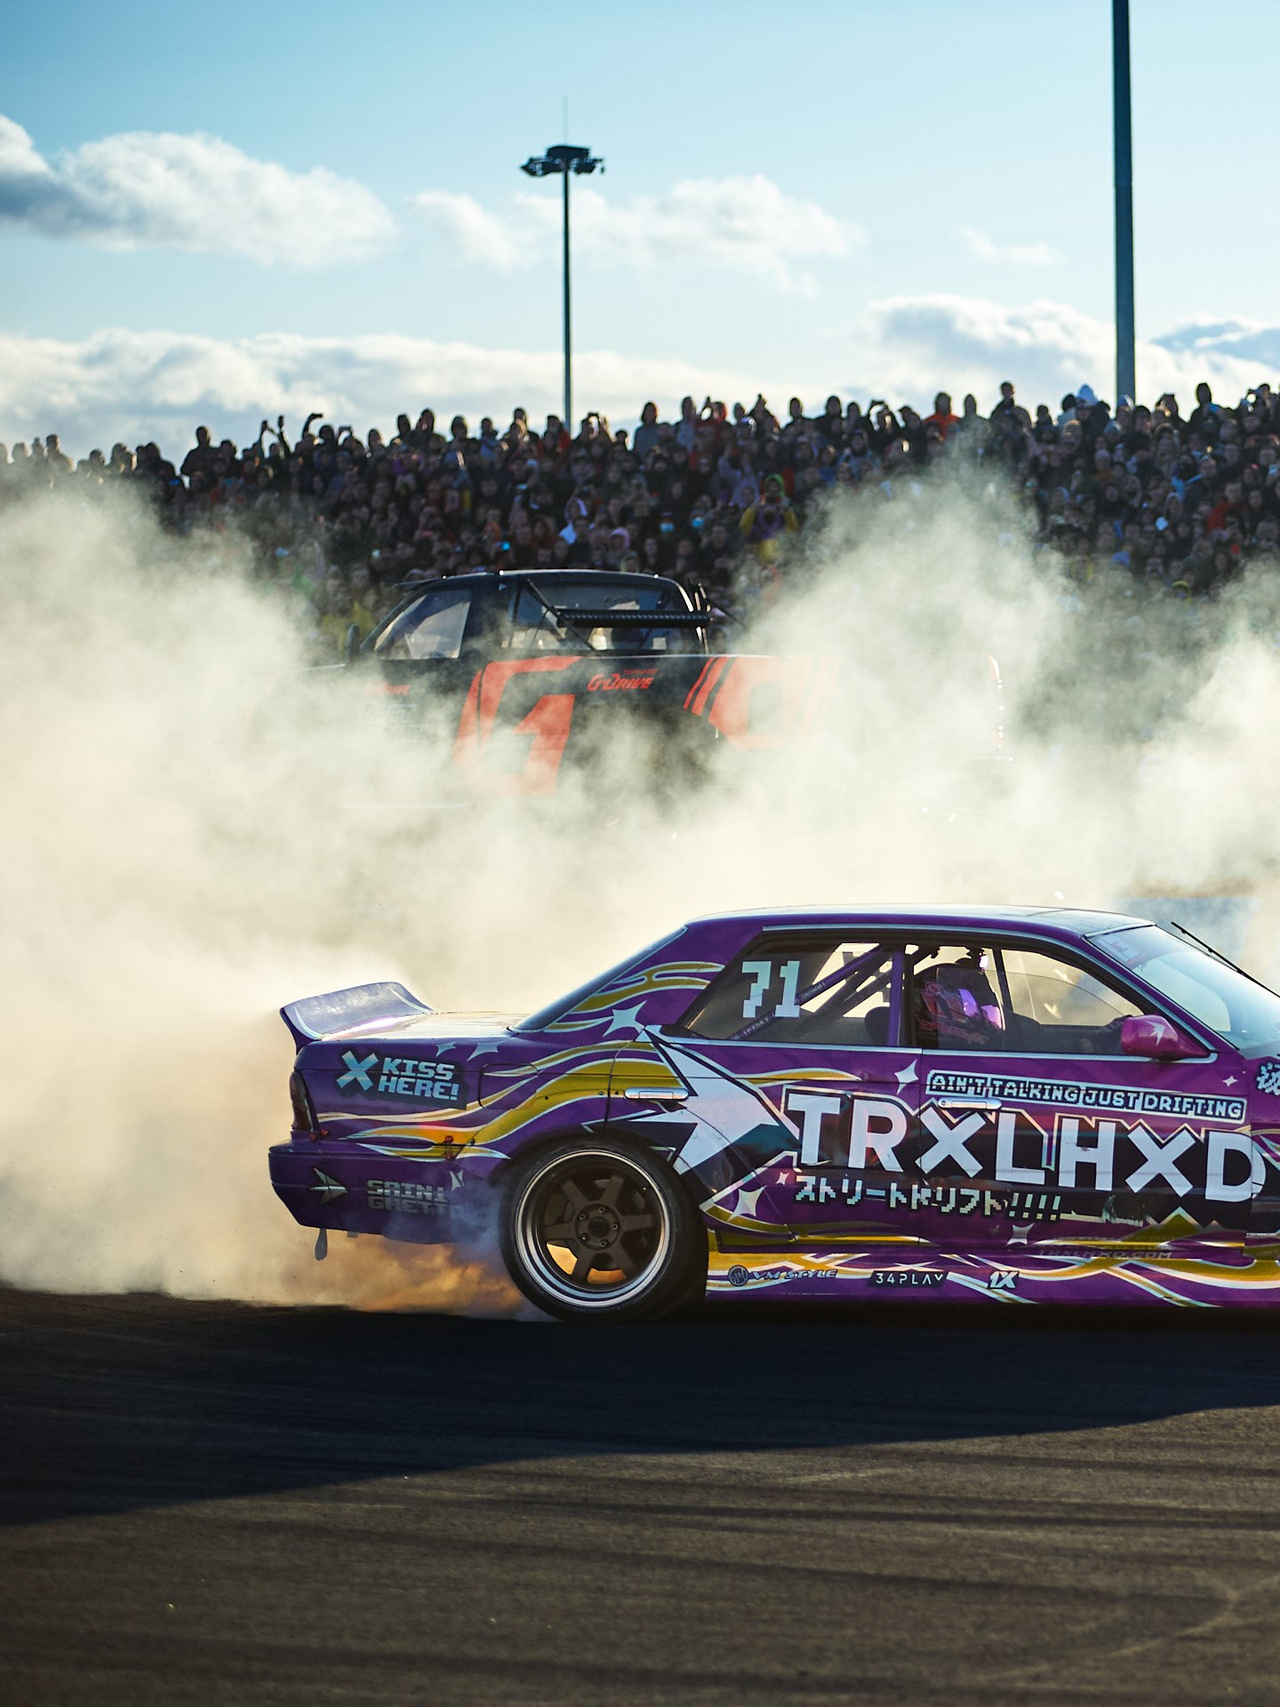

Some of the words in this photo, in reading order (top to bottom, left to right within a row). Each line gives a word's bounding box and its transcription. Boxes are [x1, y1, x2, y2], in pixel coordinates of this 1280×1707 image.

[741, 960, 801, 1018] 71
[382, 1057, 455, 1081] KISS
[378, 1075, 460, 1101] HERE!
[930, 1074, 986, 1096] AIN'T
[992, 1081, 1079, 1103] TALKING
[1084, 1089, 1138, 1109] JUST
[1142, 1094, 1242, 1117] DRIFTING
[787, 1094, 1266, 1202] TRXLHXD
[989, 1270, 1019, 1289] 1X
